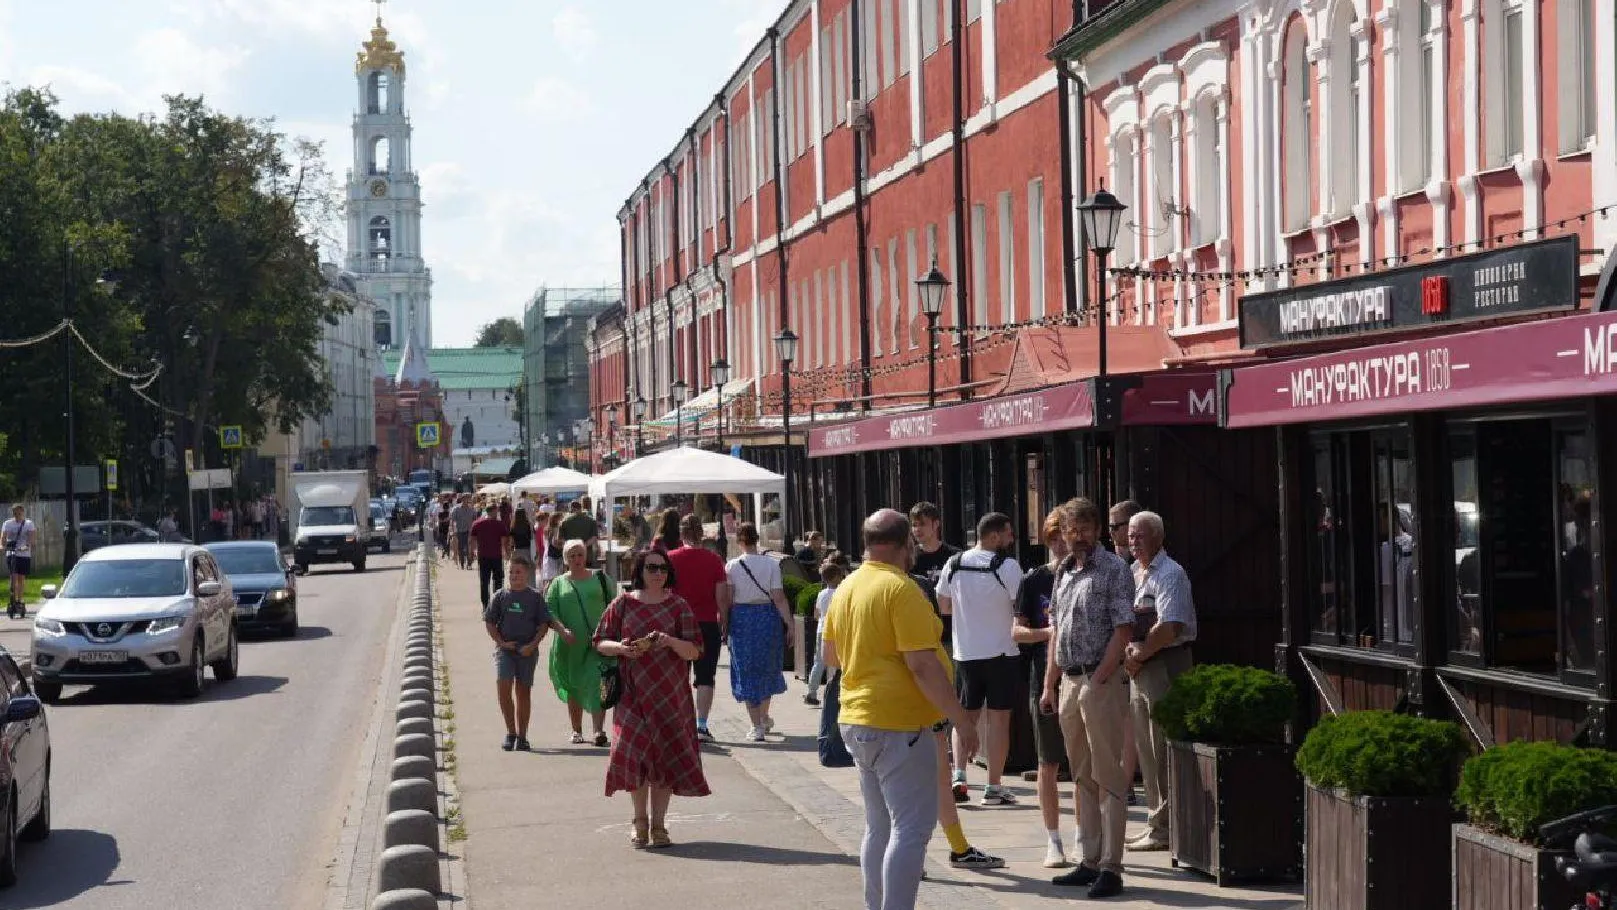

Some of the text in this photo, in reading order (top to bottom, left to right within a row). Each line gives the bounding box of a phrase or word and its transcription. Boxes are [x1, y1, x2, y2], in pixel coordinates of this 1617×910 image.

[1279, 286, 1386, 334] МАНУФАКТУРА
[1291, 347, 1450, 408] МАНУФАКТУРА 1858
